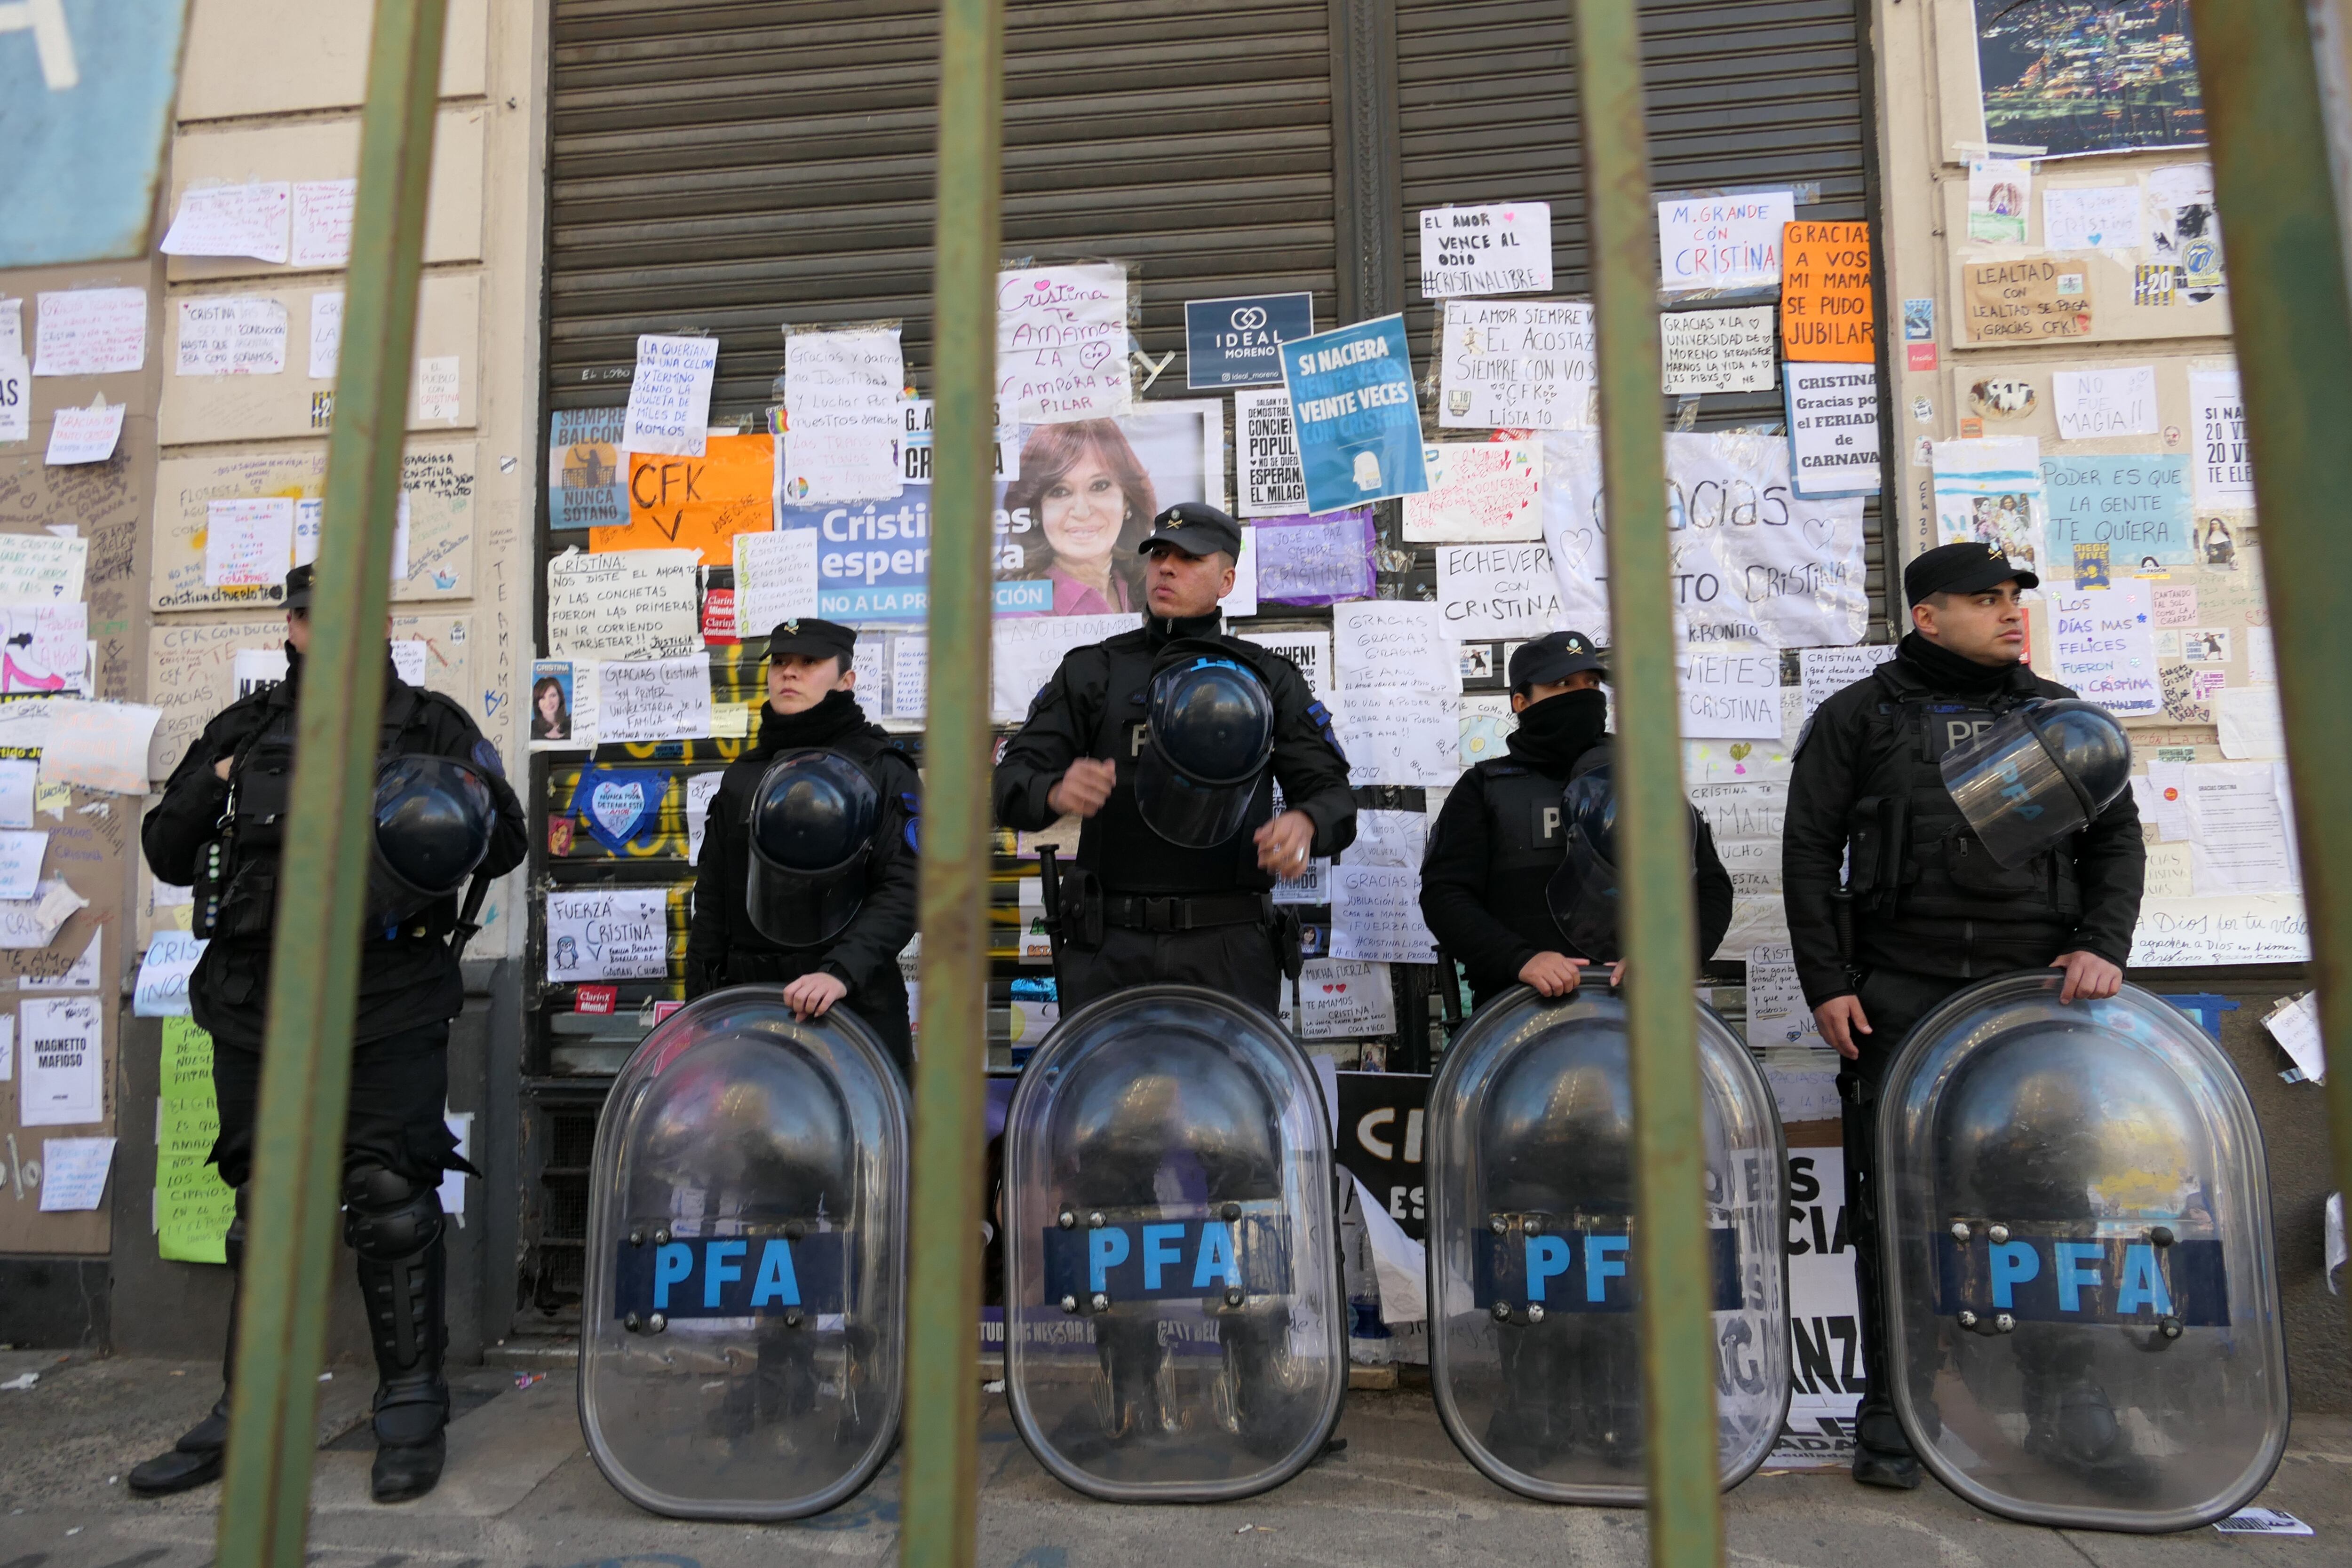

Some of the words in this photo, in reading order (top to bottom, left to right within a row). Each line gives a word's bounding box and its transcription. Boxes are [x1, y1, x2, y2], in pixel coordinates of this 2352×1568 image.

[1425, 217, 1442, 228] EL
[1454, 214, 1490, 227] AMOR
[1439, 235, 1490, 250] VENCE
[1502, 233, 1520, 246] AL
[1439, 253, 1475, 266] ODIO
[1676, 241, 1774, 275] CRISTINA
[1826, 251, 1867, 266] VOS
[1422, 269, 1538, 294] #CRISTINALIBRE
[1789, 274, 1808, 288] MI
[1825, 273, 1870, 288] MAMA
[1977, 263, 2054, 285] LEALTAD
[2137, 272, 2171, 295] +20
[998, 278, 1109, 312] Cristina
[2003, 288, 2026, 299] CON
[1788, 297, 1806, 314] SE
[1821, 297, 1863, 315] PUDO
[1973, 304, 2030, 317] LEALTAD
[2055, 300, 2090, 312] PAGA
[1043, 309, 1078, 322] Te
[1448, 306, 1472, 325] EL
[1479, 308, 1517, 324] AMOR
[1524, 309, 1581, 325] SIEMPRE
[1664, 318, 1714, 331] GRACIAS
[1729, 317, 1743, 327] LA
[2042, 320, 2077, 334] CFK!
[1013, 321, 1121, 347] AMAMOS
[1216, 330, 1283, 348] IDEAL
[1487, 328, 1510, 352] EL
[1667, 334, 1742, 345] UNIVERSIDAD
[1789, 322, 1874, 344] JUBILAR
[644, 340, 657, 354] LA
[662, 343, 710, 356] QUERIAN
[1225, 347, 1275, 358] MORENO
[1299, 354, 1316, 375] SI
[1318, 336, 1390, 372] NACIERA
[1670, 349, 1717, 359] MORENO
[641, 357, 655, 365] EN
[660, 358, 679, 367] UNA
[684, 359, 713, 369] CELDA
[1035, 349, 1063, 366] LA
[1456, 355, 1518, 380] SIEMPRE
[1526, 361, 1554, 380] CON
[1565, 360, 1595, 381] VOS
[1707, 362, 1717, 370] LA
[1721, 362, 1744, 371] VIDA
[582, 370, 596, 380] EL
[653, 372, 694, 382] TERMINO
[1232, 371, 1279, 380] ideal_moreno
[1295, 370, 1352, 398] VEINTE
[1351, 358, 1404, 386] VECES
[1799, 375, 1876, 389] CRISTINA
[635, 382, 671, 393] SIENDO
[1507, 384, 1543, 399] CFK
[2078, 379, 2103, 394] NO
[635, 395, 674, 405] JULIETA
[679, 397, 689, 407] DE
[1041, 398, 1092, 412] PILAR
[1298, 392, 1357, 423] VEINTE
[1357, 382, 1409, 409] VECES
[1797, 397, 1853, 409] Gracias
[2078, 398, 2112, 411] FUE
[561, 408, 625, 425] SIEMPRE
[638, 408, 667, 420] MILES
[675, 411, 686, 421] DE
[1490, 409, 1529, 425] LISTA
[1537, 409, 1551, 424] 10
[1798, 418, 1811, 429] el
[1815, 414, 1878, 428] FERIAD
[2206, 408, 2217, 419] SI
[559, 421, 622, 444] BALCÓN
[636, 422, 684, 436] ROMEOS
[1302, 422, 1335, 444] CON
[1340, 408, 1412, 438] CRISTINA
[2206, 424, 2222, 440] 20
[1250, 438, 1297, 456] POPUL
[1835, 436, 1853, 445] de
[1802, 452, 1880, 467] CARNAVA
[2208, 443, 2225, 464] 20
[2039, 462, 2101, 486] PODER
[2114, 470, 2139, 485] ES
[2148, 470, 2181, 487] QUE
[2209, 467, 2223, 483] TE
[633, 462, 706, 509] CFK
[565, 491, 613, 505] NUNCA
[2070, 497, 2090, 513] LA
[2101, 496, 2161, 513] GENTE
[995, 507, 1032, 534] es
[2050, 518, 2080, 542] TE
[553, 554, 625, 572] CRISTINA:
[554, 576, 575, 587] NOS
[587, 573, 619, 583] DISTE
[657, 568, 683, 577] AHORA
[1746, 562, 1847, 602] CRISTINA
[554, 595, 560, 605] Y
[570, 593, 588, 603] LAS
[598, 586, 666, 600] CONCHETAS
[1494, 582, 1530, 593] CON
[2153, 590, 2191, 600] CANTANDO
[553, 606, 595, 620] FUERON
[607, 607, 626, 618] LAS
[636, 601, 694, 612] PRIMERAS
[822, 598, 850, 612] NO
[856, 597, 868, 610] A
[873, 596, 897, 610] LA
[1445, 594, 1562, 621] CRISTINA
[2059, 599, 2090, 611] LOS
[553, 626, 567, 637] EN
[576, 625, 589, 635] IR
[598, 621, 662, 633] CORRIENDO
[1689, 621, 1758, 642] K.BONITO
[2058, 619, 2092, 635] DÍAS
[2102, 619, 2132, 631] MAS
[556, 643, 564, 653] A
[572, 634, 646, 649] TARJETEAR!!
[650, 637, 693, 647] JUSTICIA
[2059, 639, 2126, 654] FELICES
[660, 647, 693, 657] SOCIAL
[606, 666, 655, 685] GRACIAS
[660, 664, 699, 679] CRISTINA
[2062, 661, 2113, 674] FUERON
[2090, 680, 2153, 692] CRISTINA
[35, 1038, 86, 1053] MAGNETTO
[39, 1054, 82, 1069] MAFIOSO
[1089, 1221, 1242, 1292] PFA
[653, 1239, 801, 1309] PFA
[1526, 1235, 1629, 1302] PF
[1989, 1240, 2174, 1315] PFA
